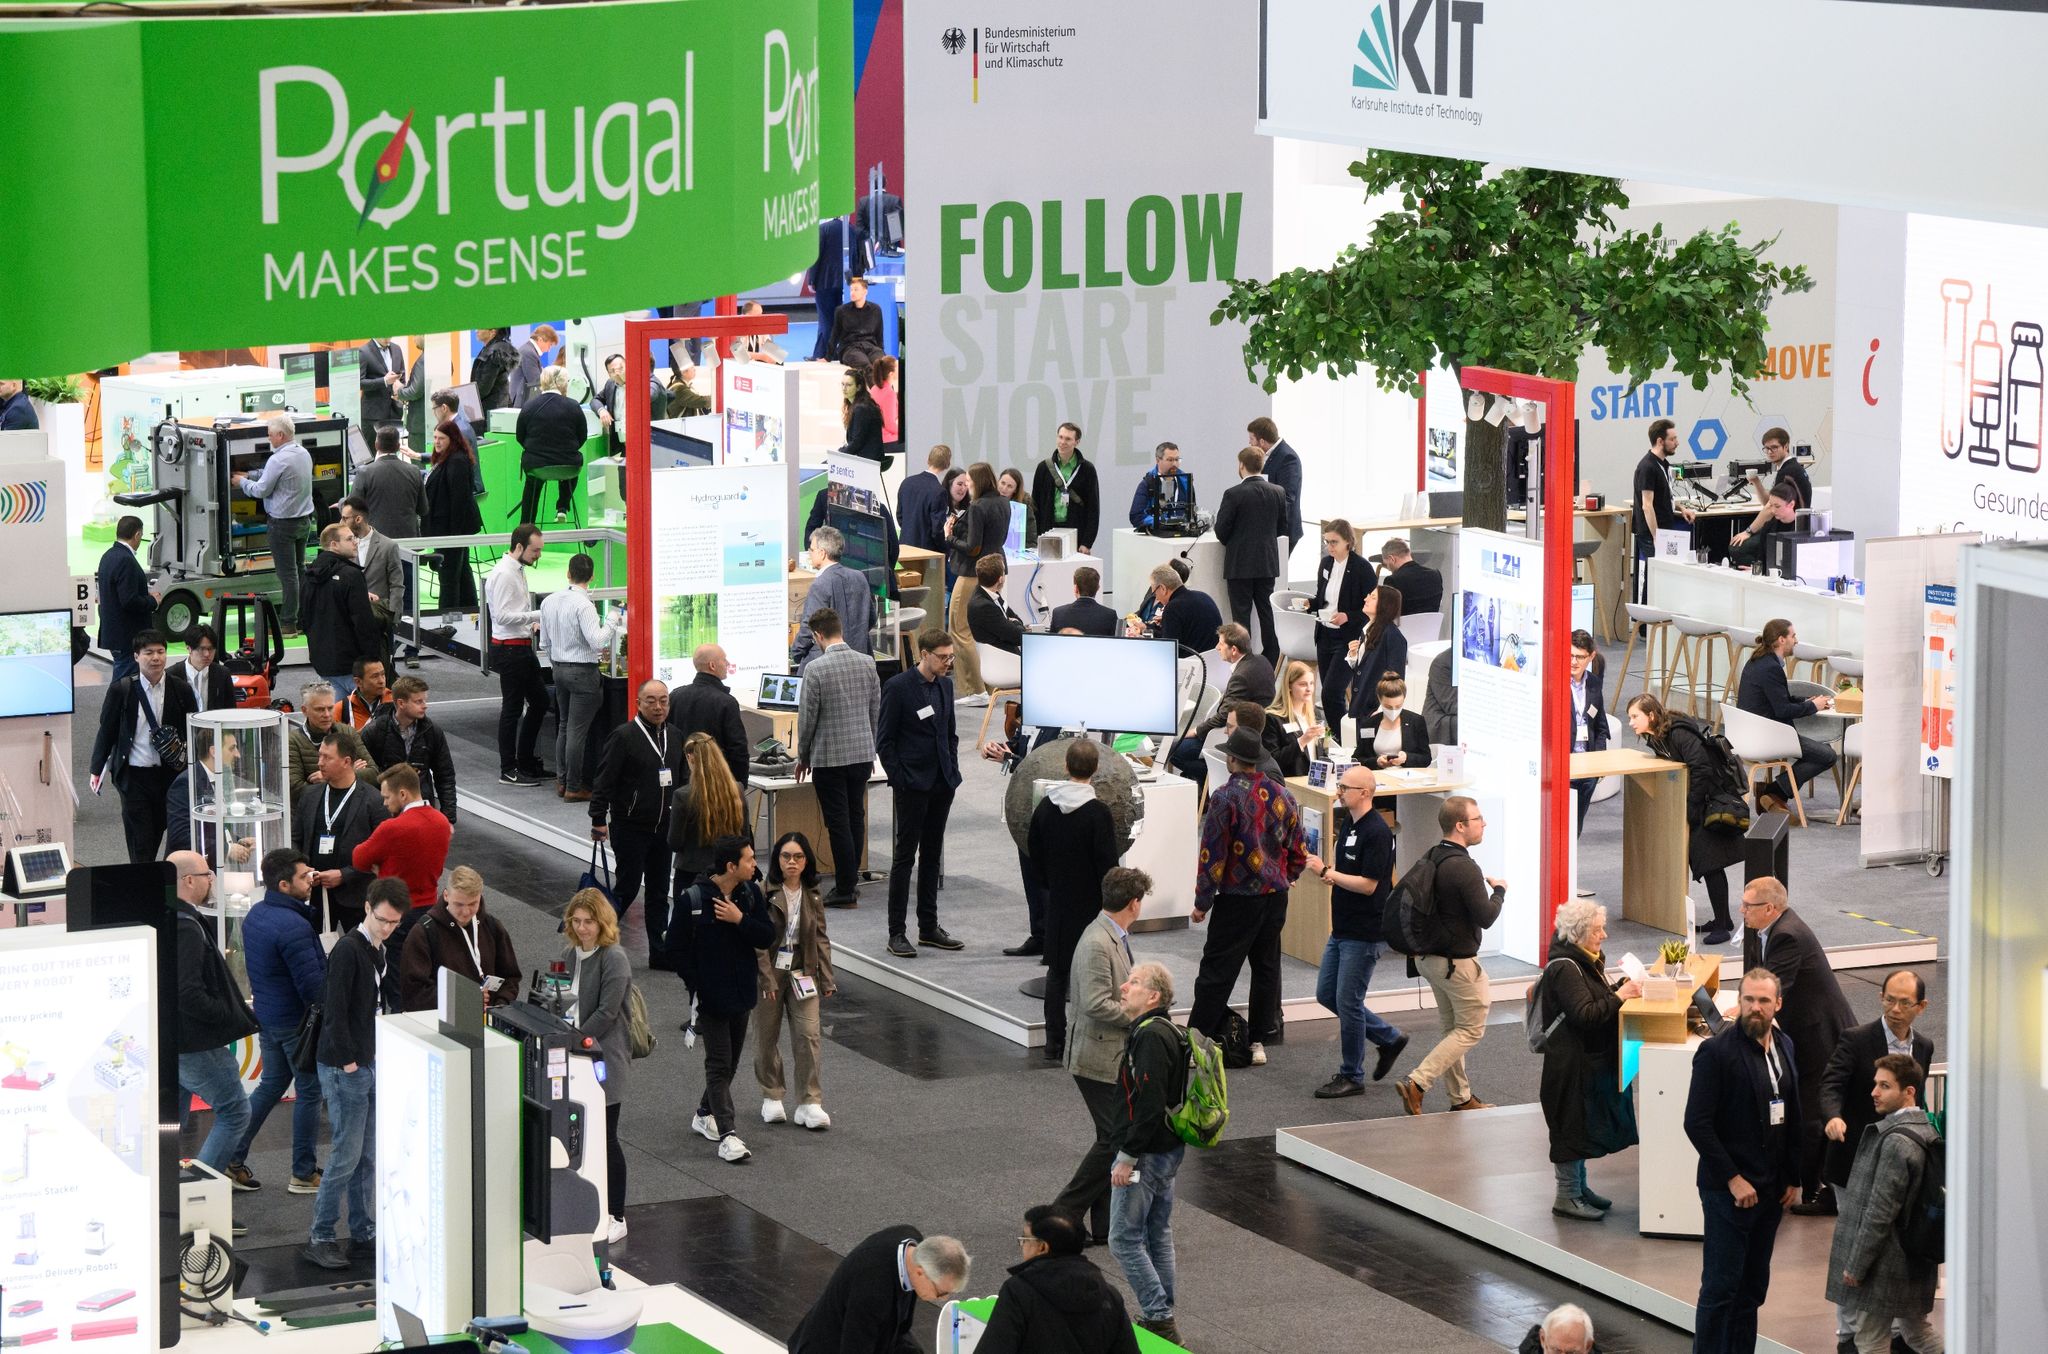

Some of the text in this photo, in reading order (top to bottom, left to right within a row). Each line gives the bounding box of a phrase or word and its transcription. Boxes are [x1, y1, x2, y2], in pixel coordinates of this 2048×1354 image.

[985, 26, 1076, 38] Bundesministerium
[985, 40, 1050, 54] für Wirtschaft
[1389, 0, 1484, 99] KIT
[985, 56, 1063, 68] und Klimaschutz
[1351, 96, 1483, 126] Karlsruhe Institute of Technology
[259, 50, 694, 239] Portugal
[764, 188, 808, 241] MAKES
[941, 192, 1243, 294] FOLLOW
[264, 230, 587, 301] MAKES SENSE
[939, 286, 1176, 386] START
[1755, 344, 1832, 383] MOVE
[245, 395, 260, 405] WTZ
[1590, 382, 1679, 421] START
[941, 377, 1151, 474] MOVE
[836, 466, 855, 478] sentics
[690, 492, 740, 503] Hydroguard
[1973, 483, 2048, 521] Gesunde
[1493, 552, 1521, 578] LZH
[77, 584, 89, 601] B
[77, 603, 89, 611] 44
[31, 961, 56, 973] OUT
[59, 958, 82, 970] THE
[85, 955, 114, 967] BEST
[118, 952, 130, 964] IN
[33, 976, 74, 988] ROBOT
[30, 1010, 63, 1023] picking
[14, 1103, 48, 1115] picking
[44, 1185, 79, 1196] Stacker
[45, 1266, 84, 1279] Delivery
[86, 1262, 119, 1273] Robots
